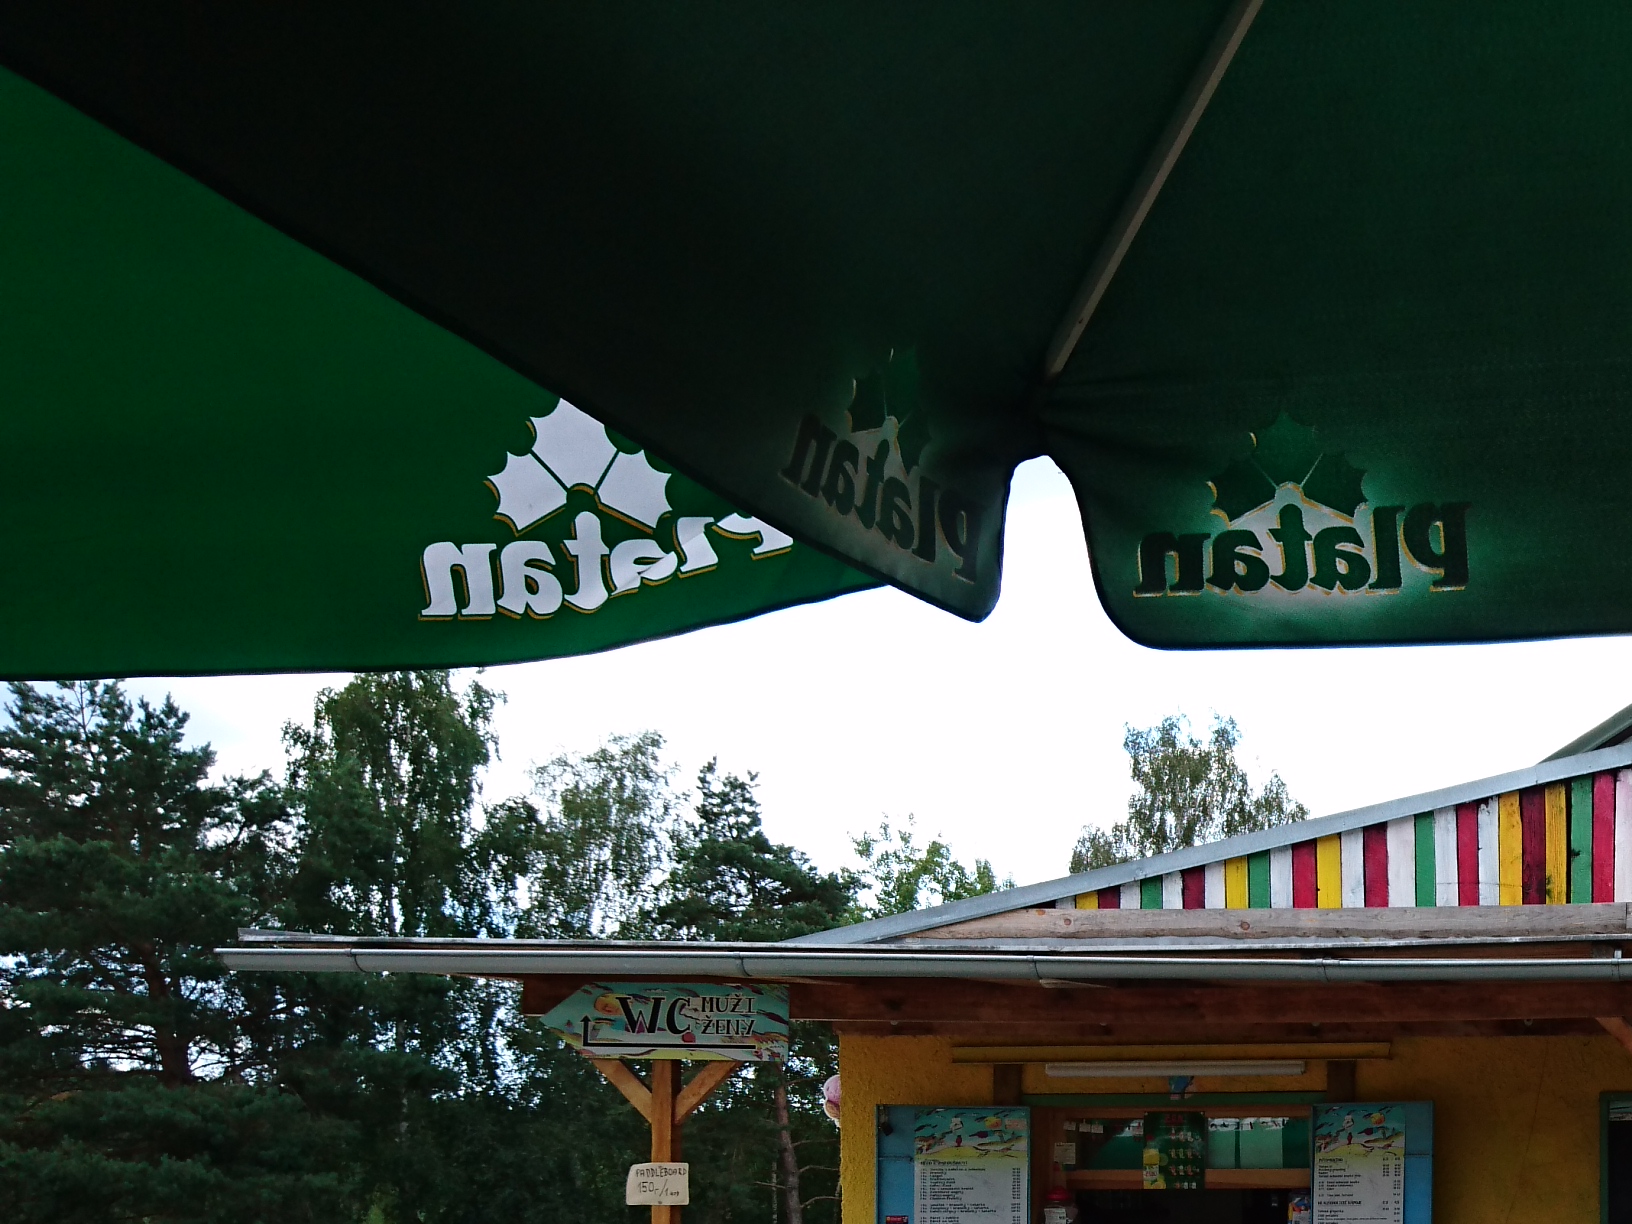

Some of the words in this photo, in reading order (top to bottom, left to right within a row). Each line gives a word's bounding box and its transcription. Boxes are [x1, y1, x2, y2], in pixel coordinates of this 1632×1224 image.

[615, 995, 691, 1035] WC
[700, 993, 758, 1015] MUŽI
[700, 1015, 756, 1035] ŽENY
[636, 1167, 687, 1177] PADDLEBOARD
